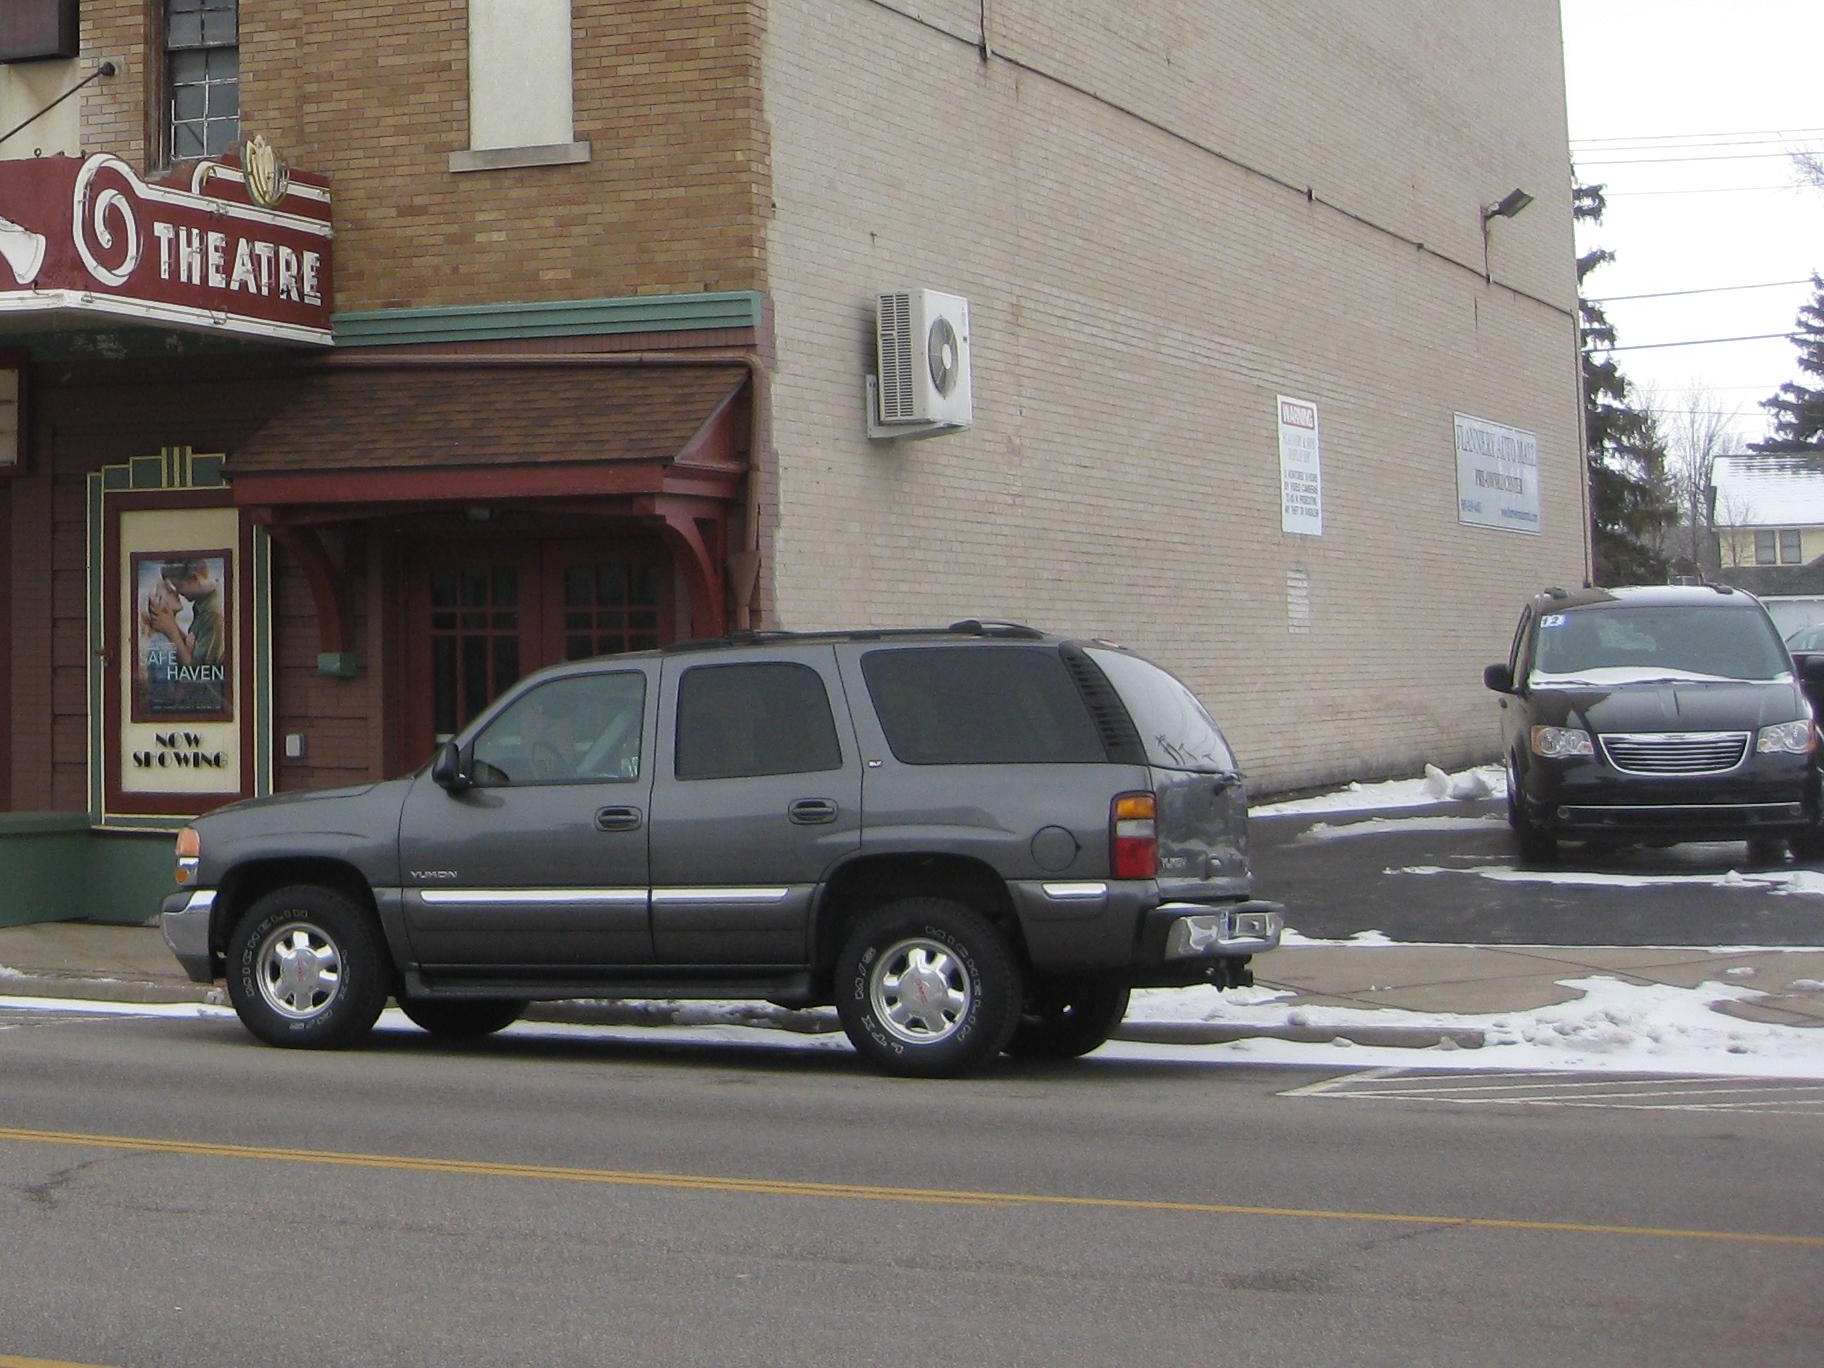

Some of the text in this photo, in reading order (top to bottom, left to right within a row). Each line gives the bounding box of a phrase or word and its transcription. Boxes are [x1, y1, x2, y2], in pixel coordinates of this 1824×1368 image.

[153, 221, 322, 307] THEATRE
[1282, 403, 1314, 427] WARNING
[139, 649, 178, 666] SAFE
[167, 664, 225, 681] HAVEN
[155, 731, 203, 749] NOW
[132, 751, 229, 769] SHOWING
[409, 870, 458, 880] YUKON
